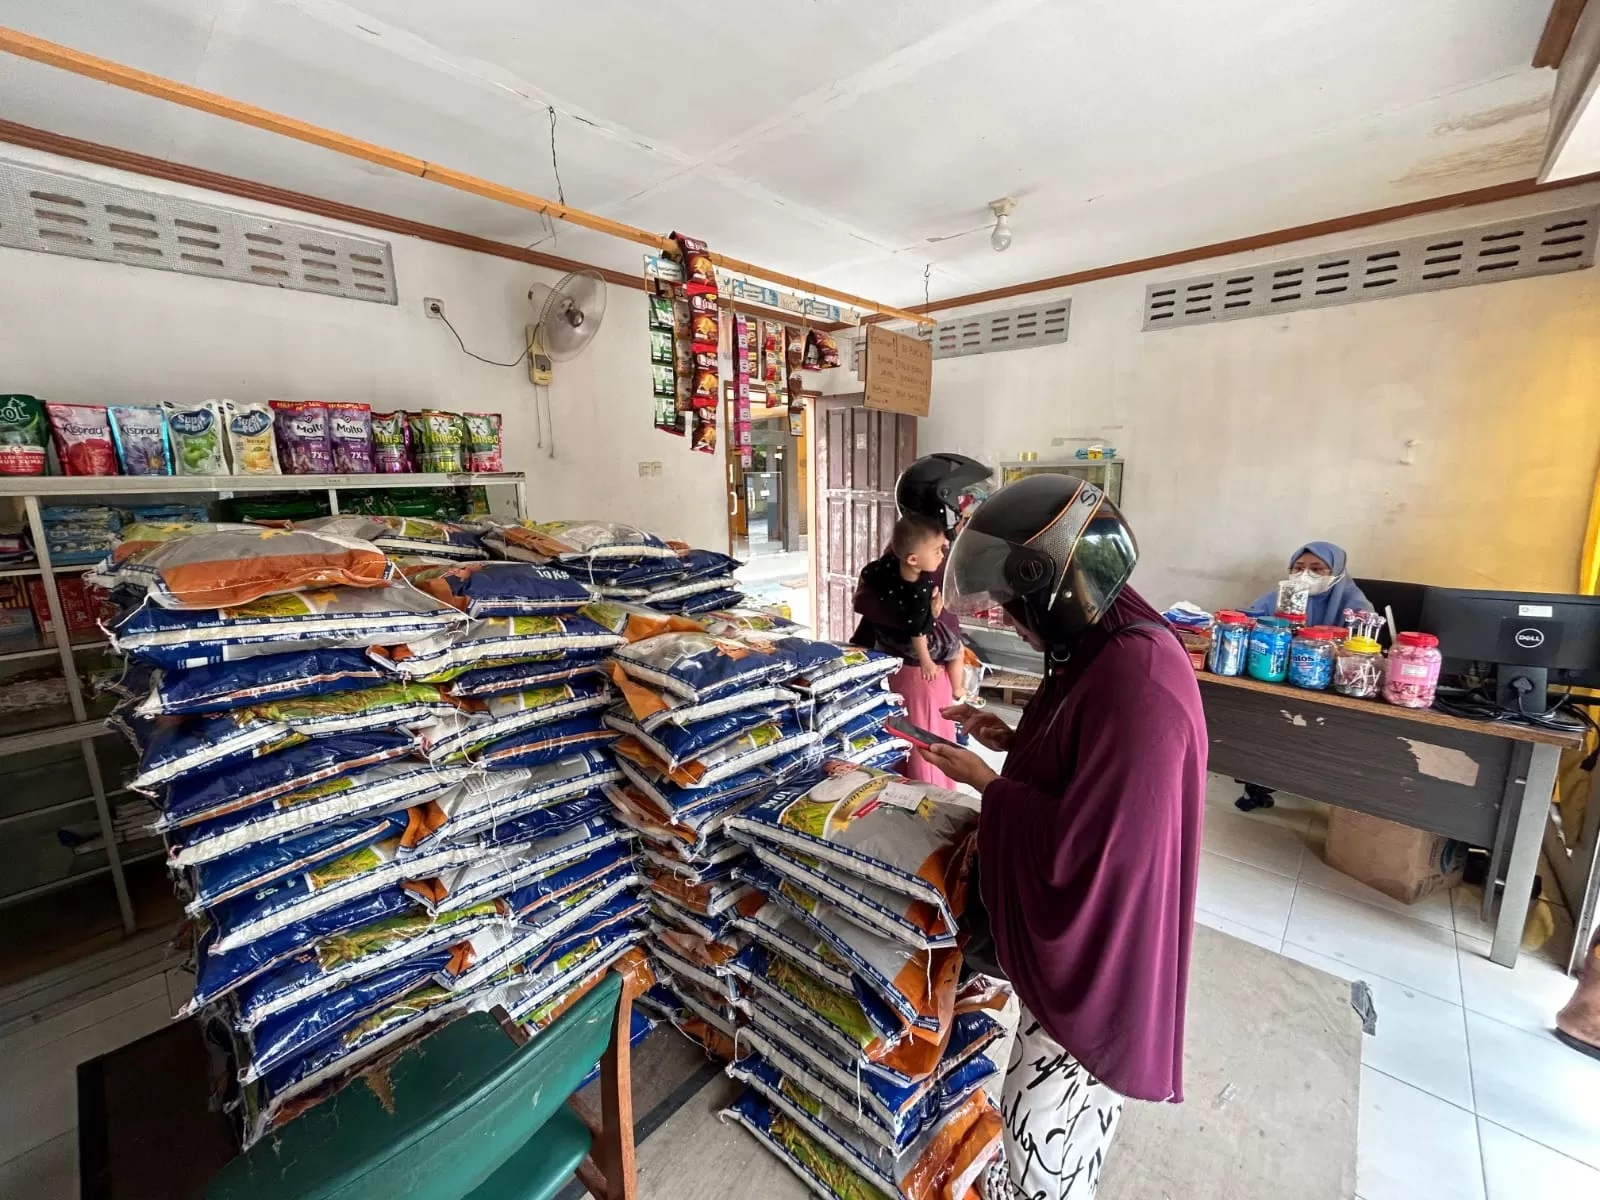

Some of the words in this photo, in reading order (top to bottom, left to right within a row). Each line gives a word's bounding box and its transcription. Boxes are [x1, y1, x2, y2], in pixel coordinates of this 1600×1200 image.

[0, 405, 30, 423] OL
[62, 423, 103, 437] Kispray
[336, 422, 363, 434] Molto
[1518, 634, 1541, 642] DELL
